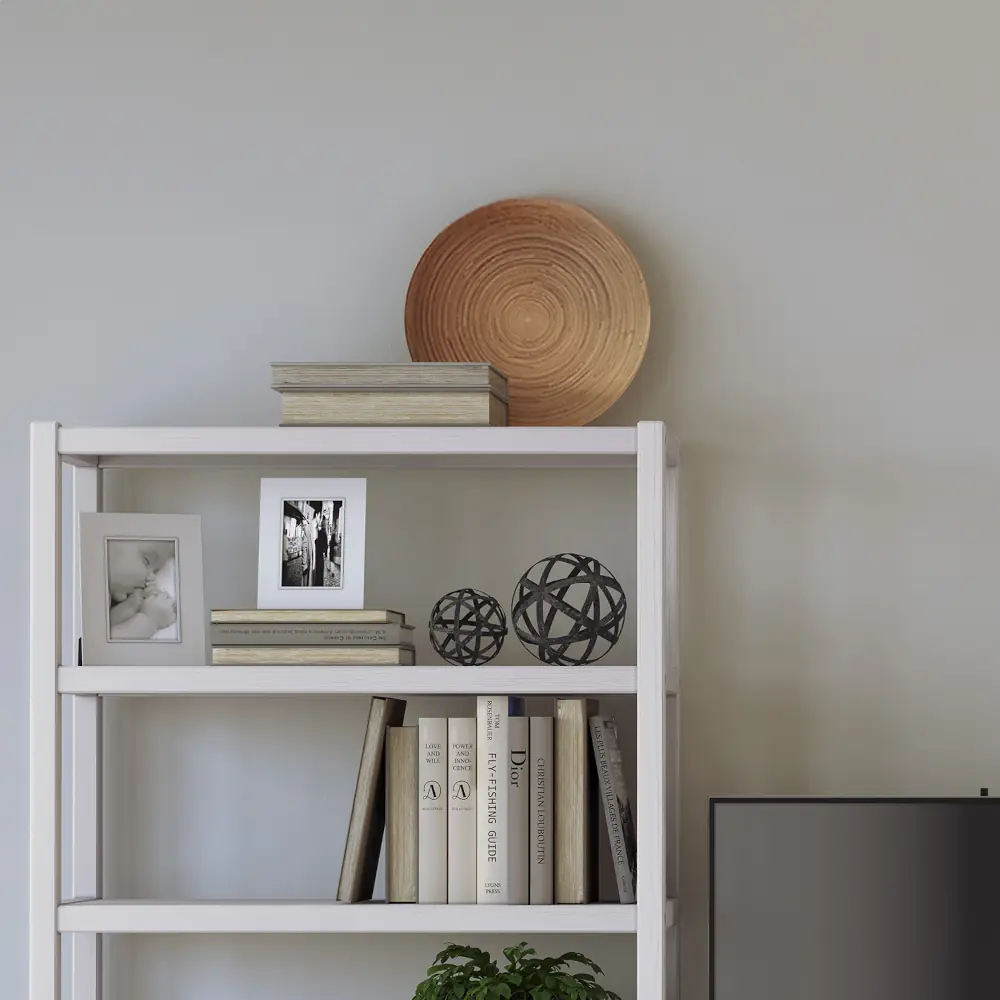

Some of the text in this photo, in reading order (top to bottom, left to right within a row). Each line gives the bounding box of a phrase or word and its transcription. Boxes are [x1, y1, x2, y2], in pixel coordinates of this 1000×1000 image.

[594, 725, 605, 741] LES
[596, 740, 606, 760] PLUS
[509, 748, 527, 788] Dior
[598, 759, 611, 786] BEAUX
[487, 752, 498, 863] FLY-FISHING GUIDE
[537, 757, 545, 865] CHRISTIAN LOUBOUTIN
[604, 785, 618, 823] VILLAGES
[610, 822, 621, 835] DE
[612, 834, 625, 866] FRANCE
